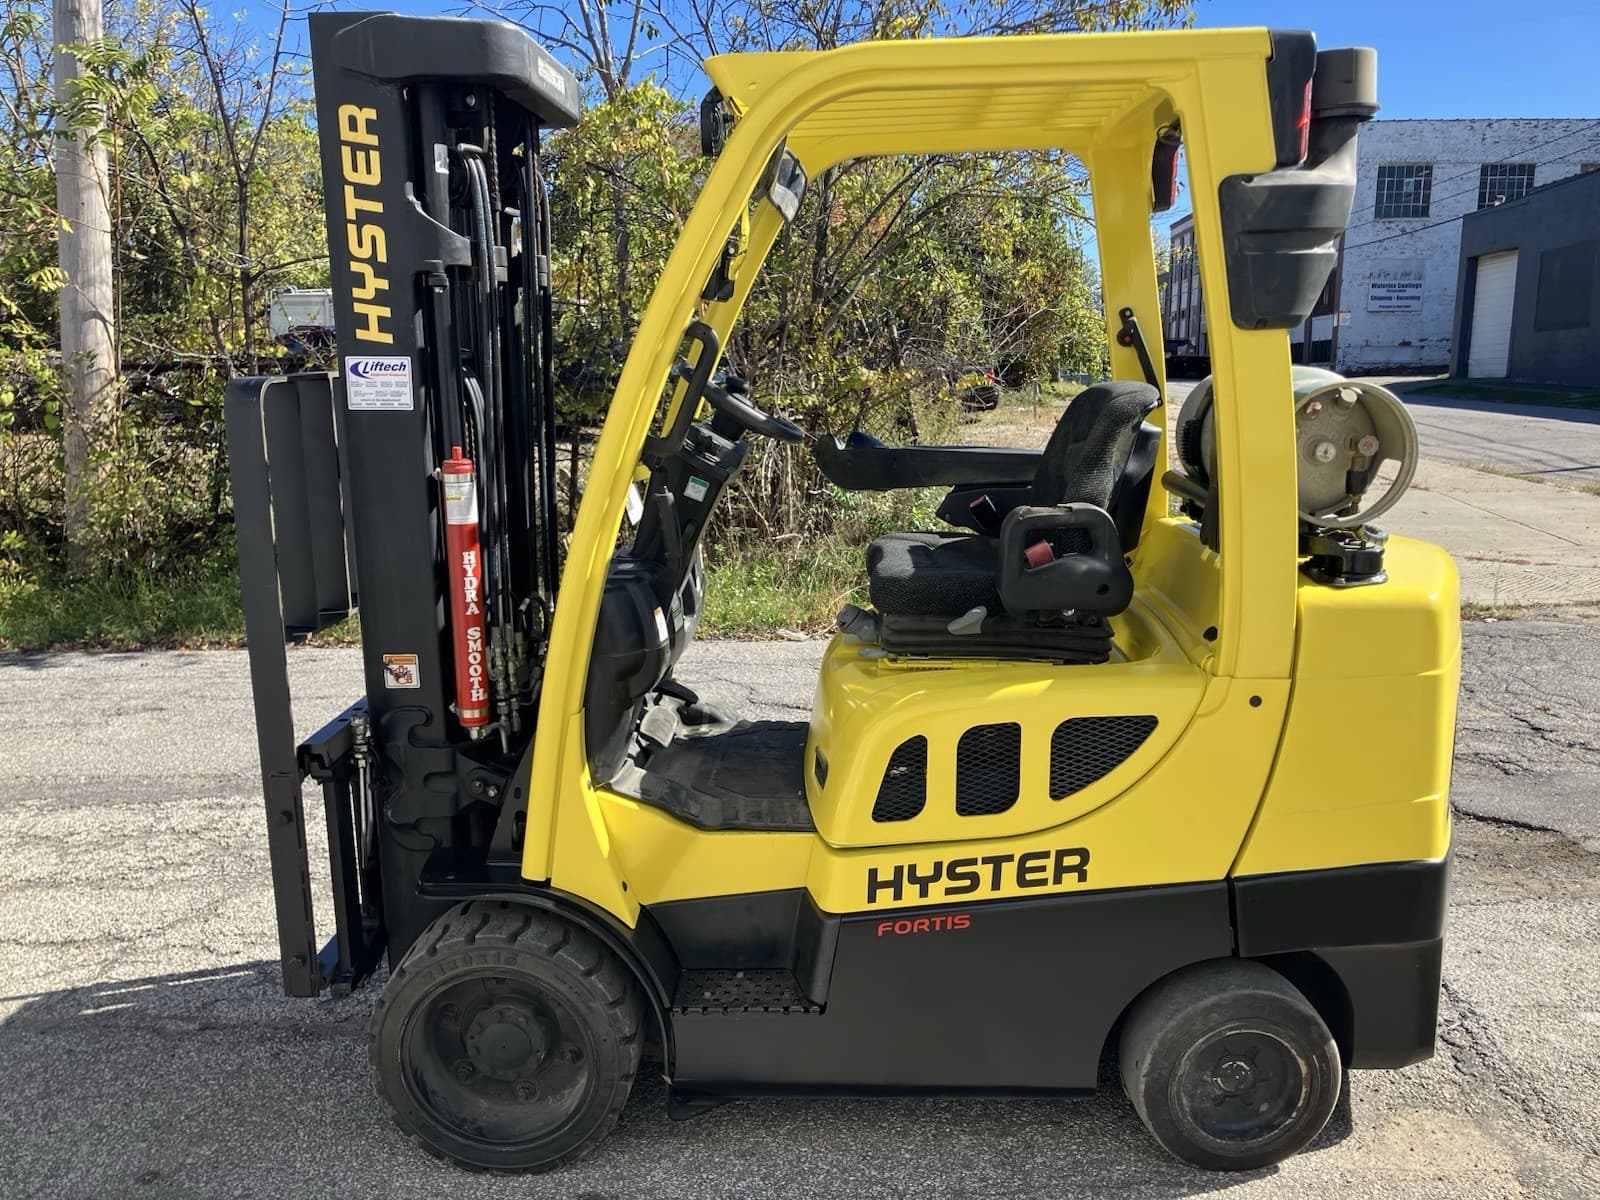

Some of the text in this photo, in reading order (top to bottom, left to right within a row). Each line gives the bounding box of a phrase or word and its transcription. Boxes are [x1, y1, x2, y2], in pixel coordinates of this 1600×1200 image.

[338, 104, 394, 344] HYSTER
[362, 361, 407, 374] Liftech
[462, 551, 485, 701] HYDRA SMOOTH
[867, 847, 1091, 904] HYSTER
[877, 914, 971, 937] FORTIS
